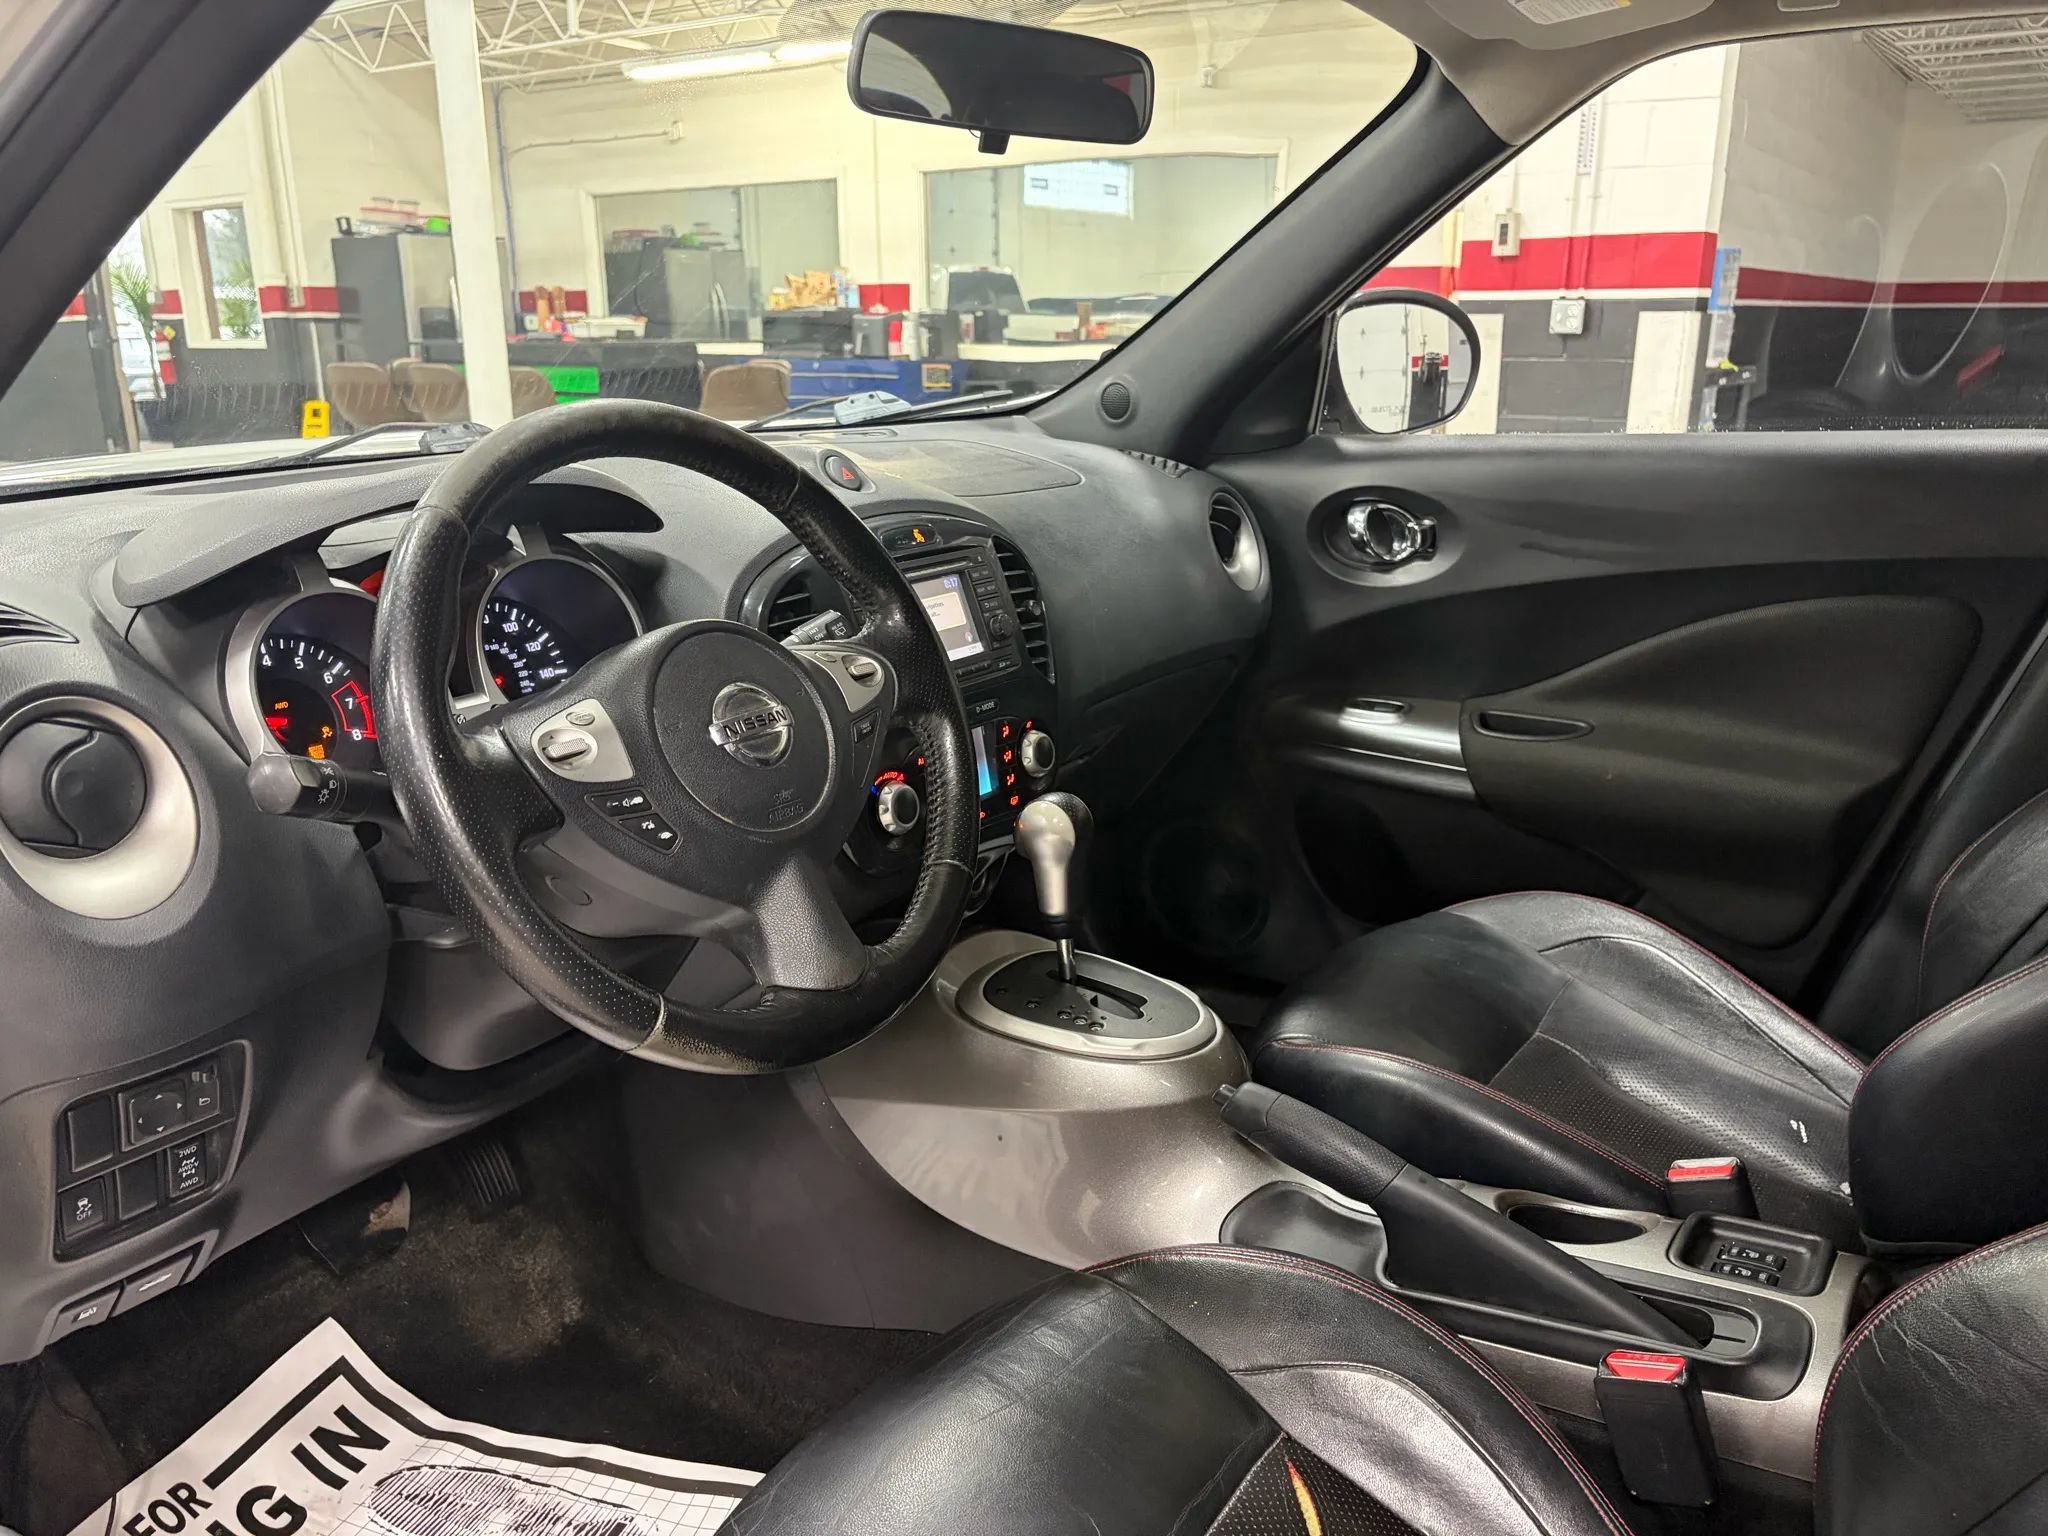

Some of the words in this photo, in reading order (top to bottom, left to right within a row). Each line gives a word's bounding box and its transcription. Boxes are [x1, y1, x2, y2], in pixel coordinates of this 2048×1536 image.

[502, 622, 519, 633] 100
[808, 627, 819, 635] INT
[525, 642, 541, 652] 120
[262, 655, 272, 667] 4
[294, 657, 304, 670] 5
[323, 672, 333, 684] 6
[539, 667, 555, 679] 140
[345, 697, 354, 709] 7
[722, 708, 788, 738] NISSAN
[352, 728, 362, 741] 8
[179, 1145, 197, 1158] 2WD
[180, 1176, 199, 1190] AWD
[76, 1210, 93, 1221] OFF
[291, 1404, 391, 1491] IN
[122, 1482, 213, 1536] FOR
